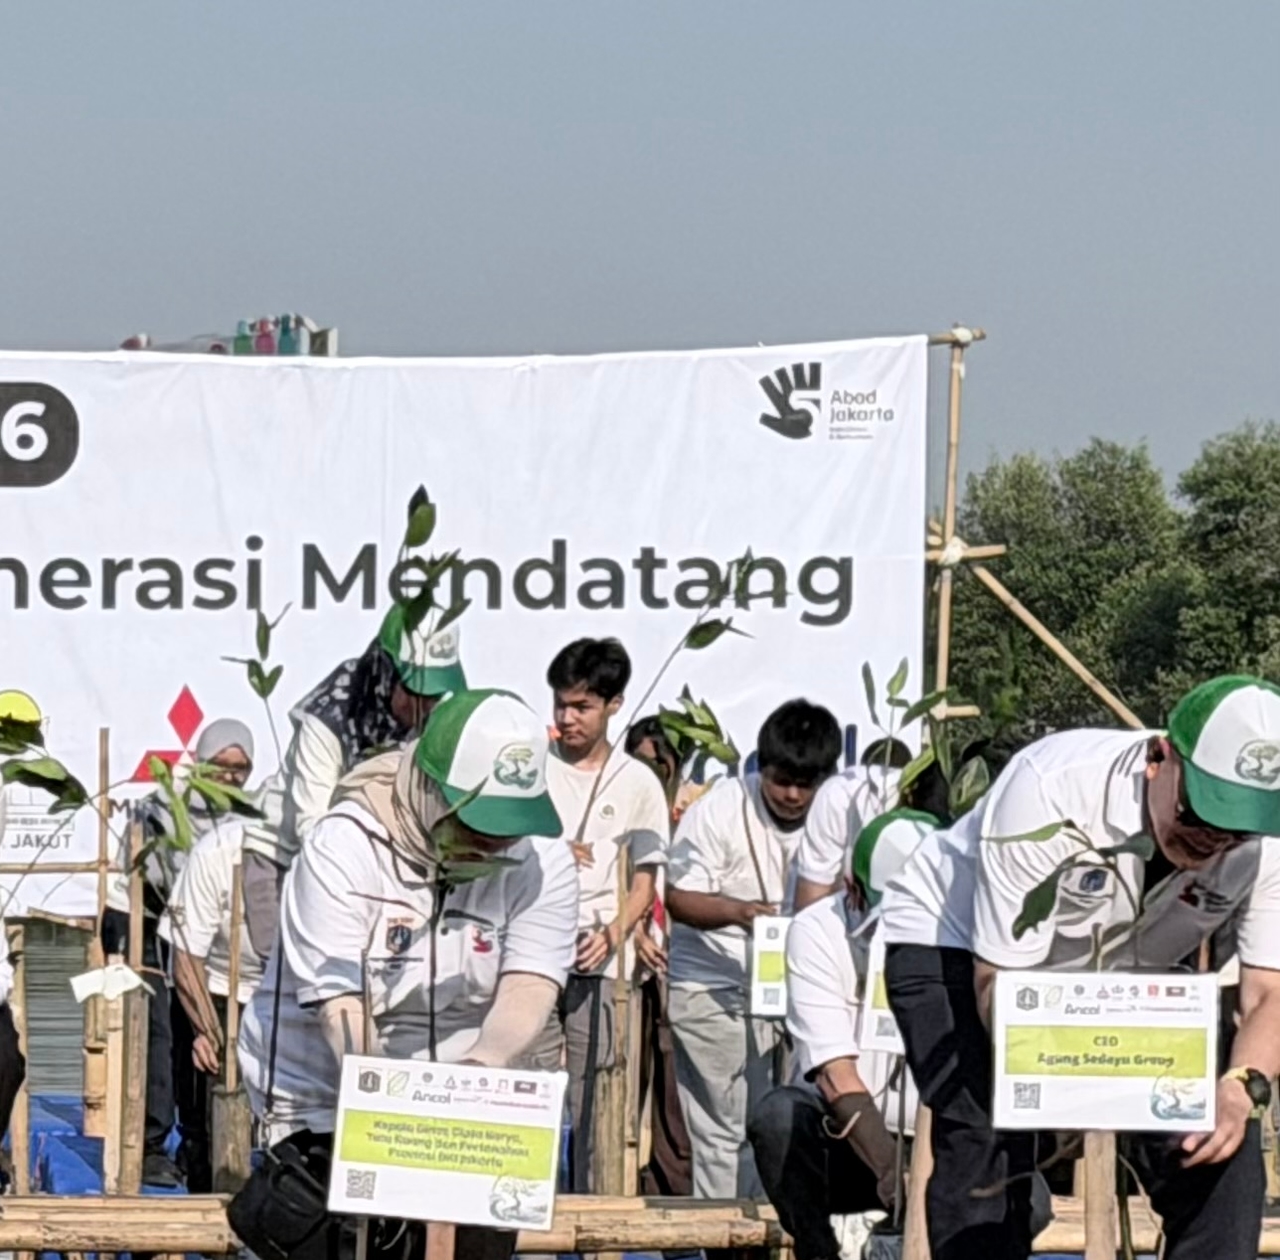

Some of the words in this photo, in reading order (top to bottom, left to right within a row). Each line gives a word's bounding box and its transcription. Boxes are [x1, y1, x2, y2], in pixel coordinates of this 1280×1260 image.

[830, 390, 876, 405] Abad
[829, 408, 895, 423] Jakarta
[302, 538, 854, 627] Mendatang
[1093, 1036, 1119, 1047] CEO
[1083, 1054, 1131, 1067] Sedayu
[1133, 1055, 1175, 1067] Group
[412, 1090, 451, 1104] Ancol
